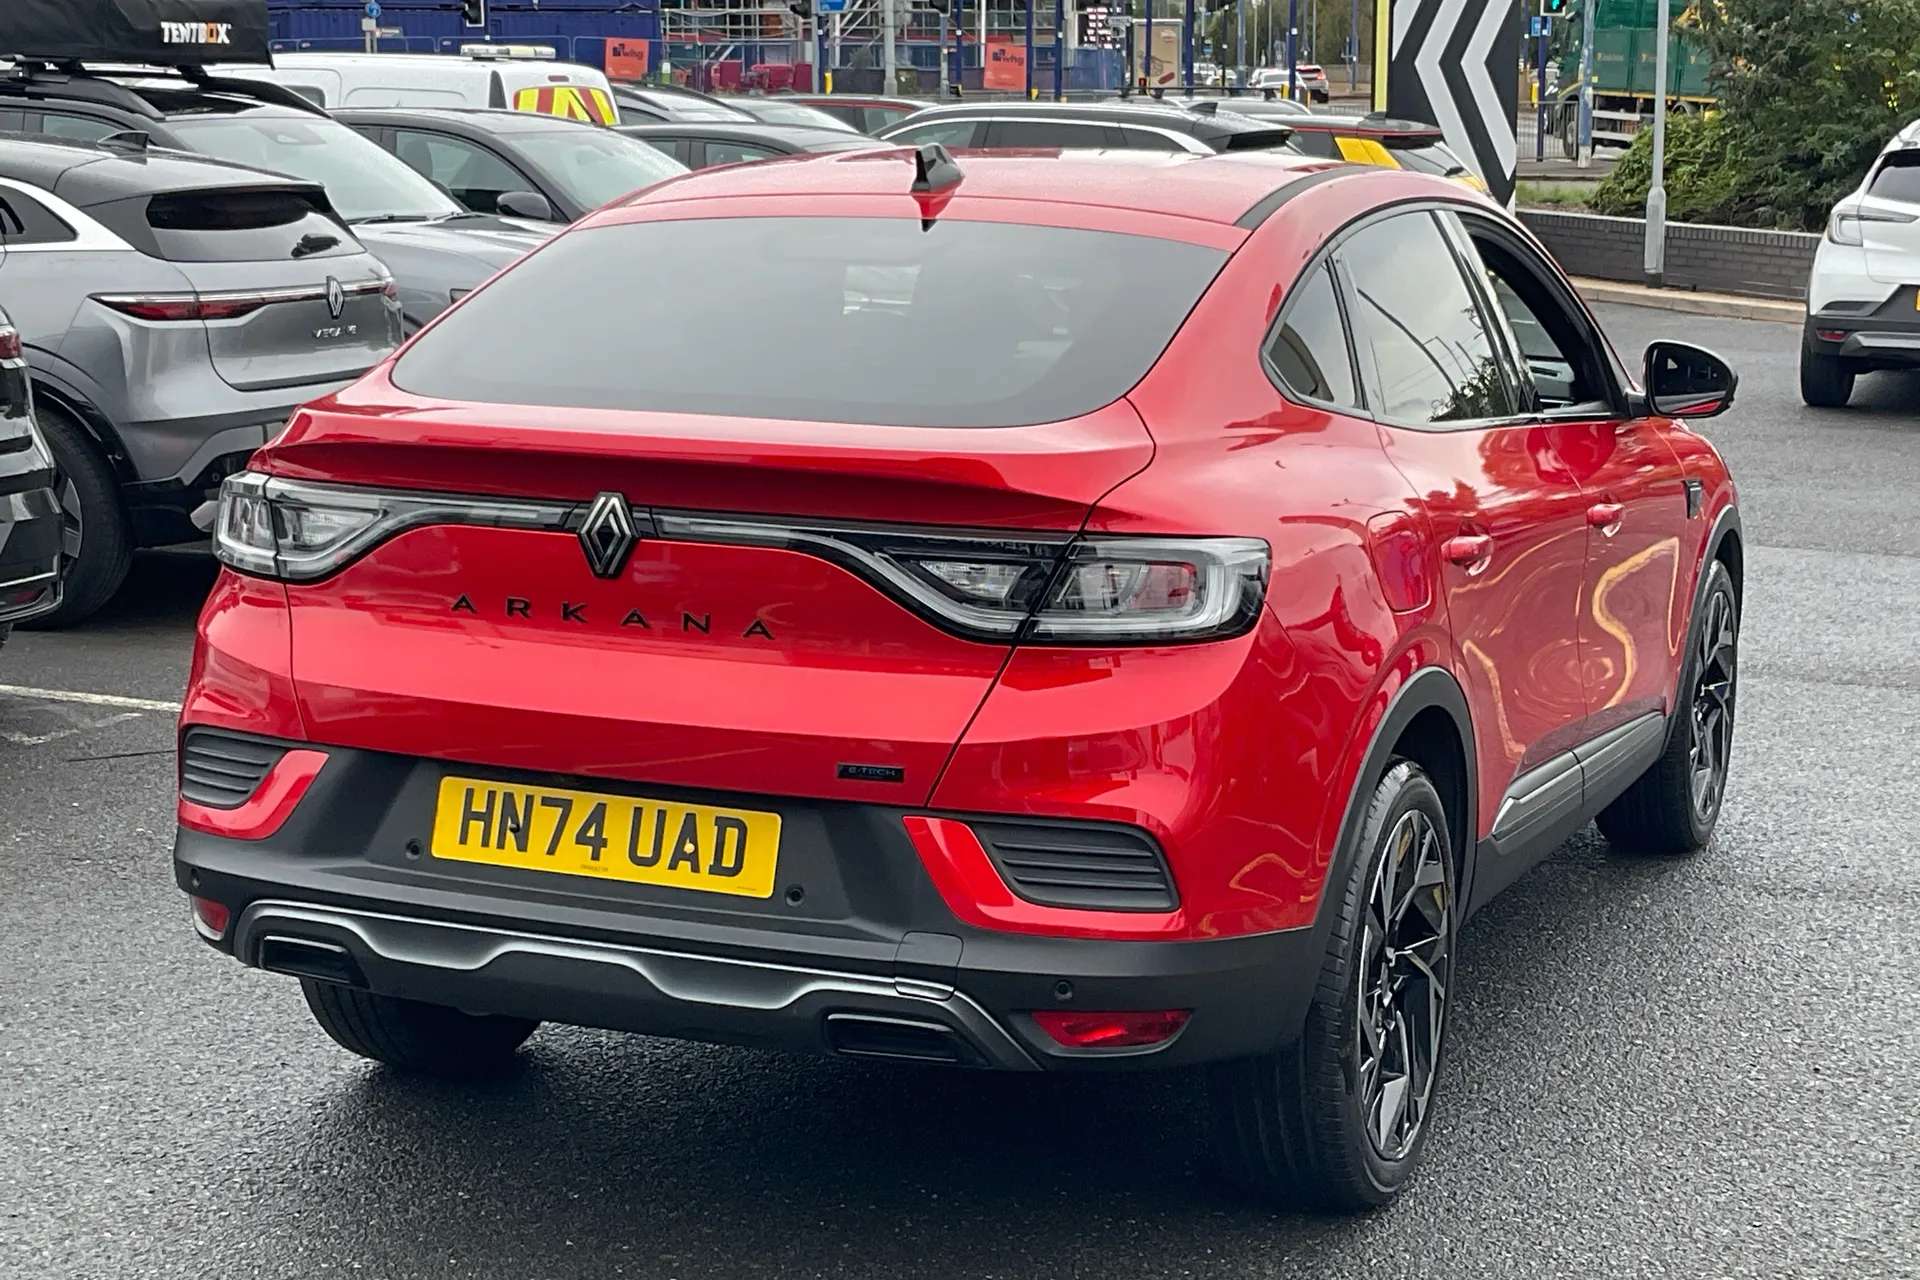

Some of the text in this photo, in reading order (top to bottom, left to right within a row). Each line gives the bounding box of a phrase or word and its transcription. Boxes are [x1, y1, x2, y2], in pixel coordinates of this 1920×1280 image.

[161, 21, 230, 43] TENTBOX
[451, 593, 775, 640] ARKANA
[459, 788, 748, 877] HN74 UAD
